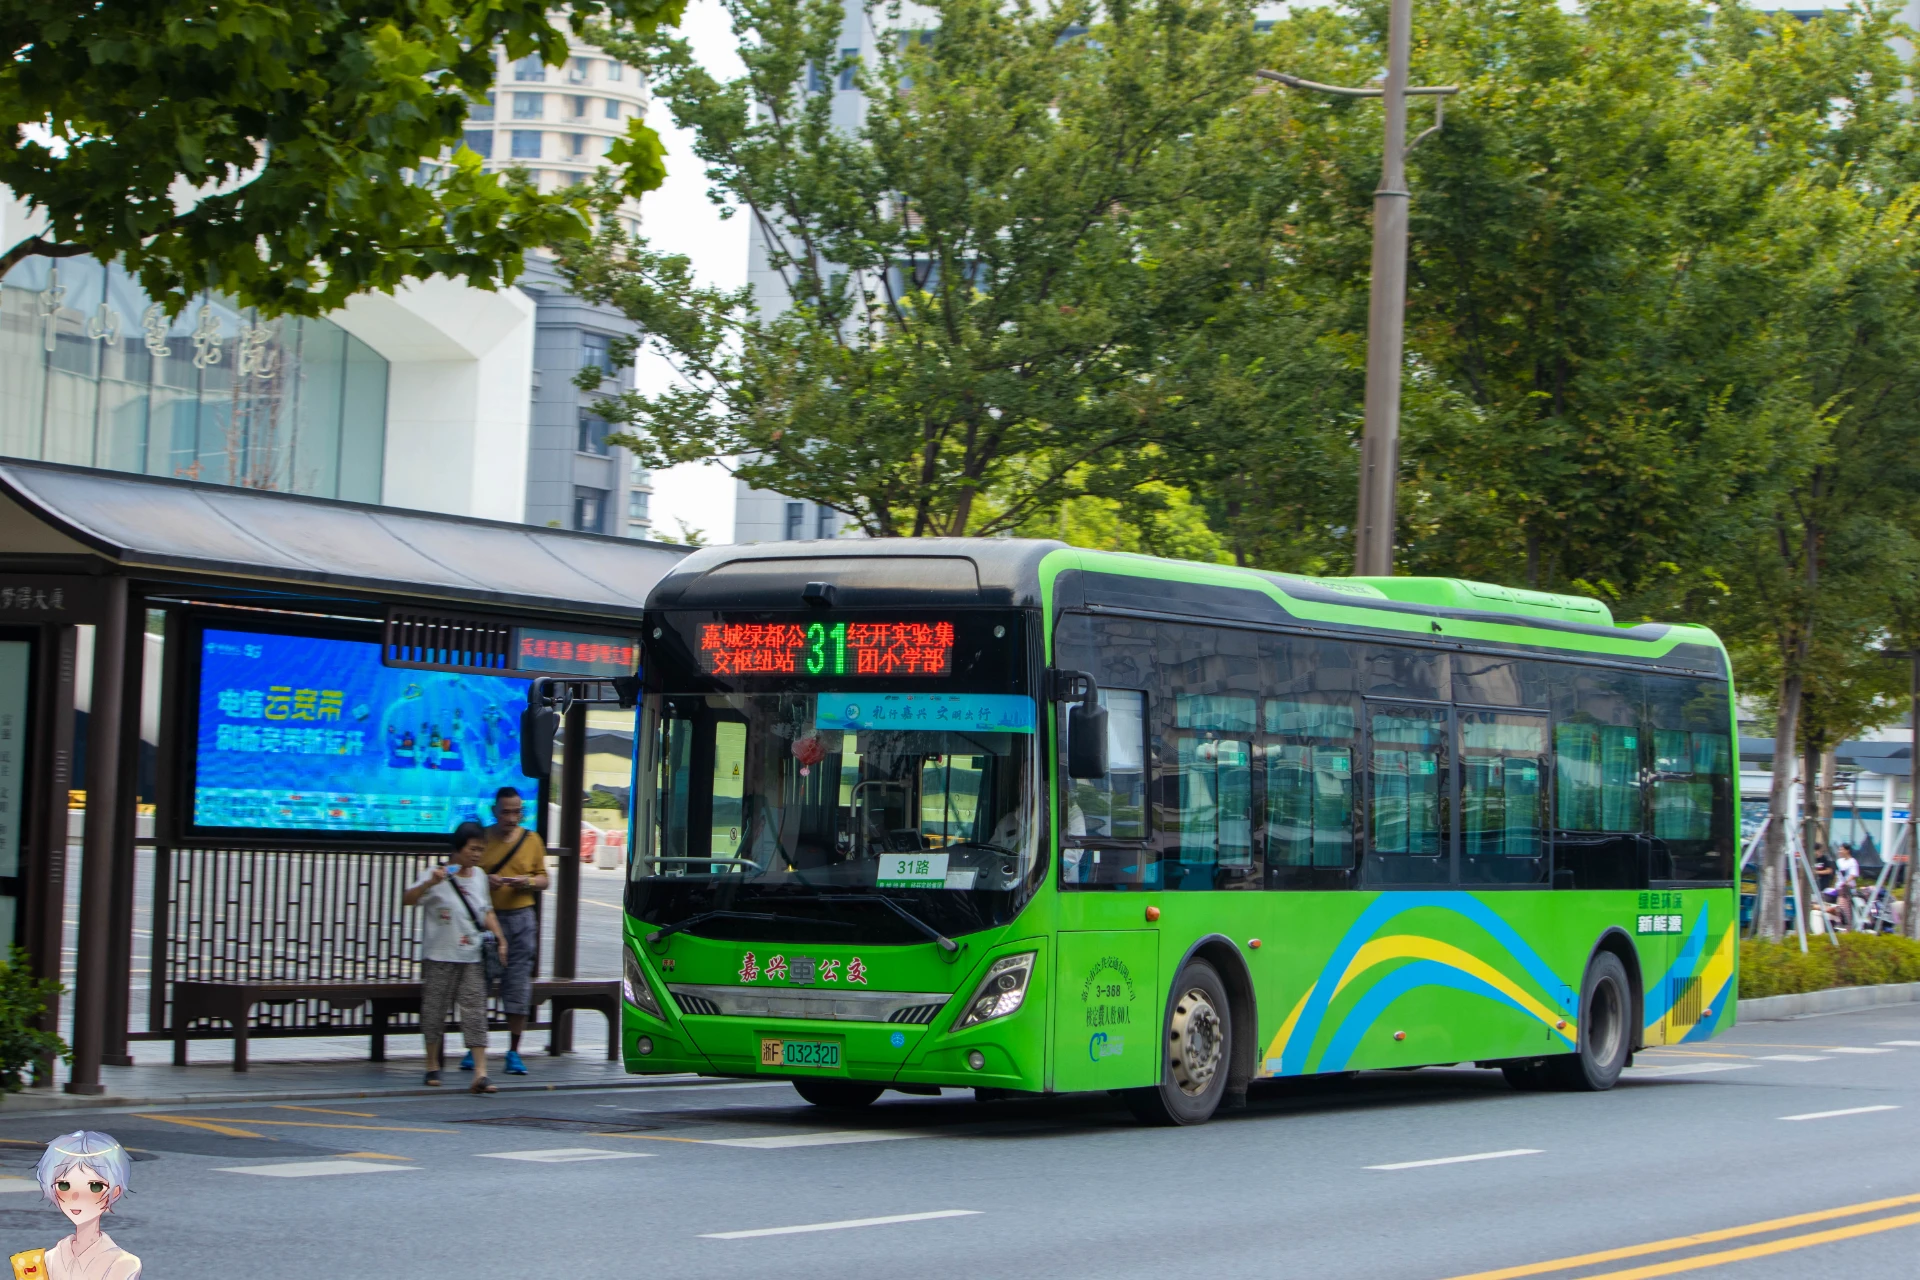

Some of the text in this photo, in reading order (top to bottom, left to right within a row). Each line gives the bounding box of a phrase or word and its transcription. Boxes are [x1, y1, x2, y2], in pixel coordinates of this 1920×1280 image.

[702, 624, 806, 649] 嘉城绿都公
[847, 622, 954, 648] 经开实验集
[807, 623, 846, 674] 31
[857, 648, 944, 673] 团小学部
[712, 649, 795, 674] 交枢纽站
[936, 705, 991, 722] 文明出行
[896, 860, 930, 875] 31路
[1638, 915, 1682, 932] 新能源
[1096, 985, 1121, 997] 3-368
